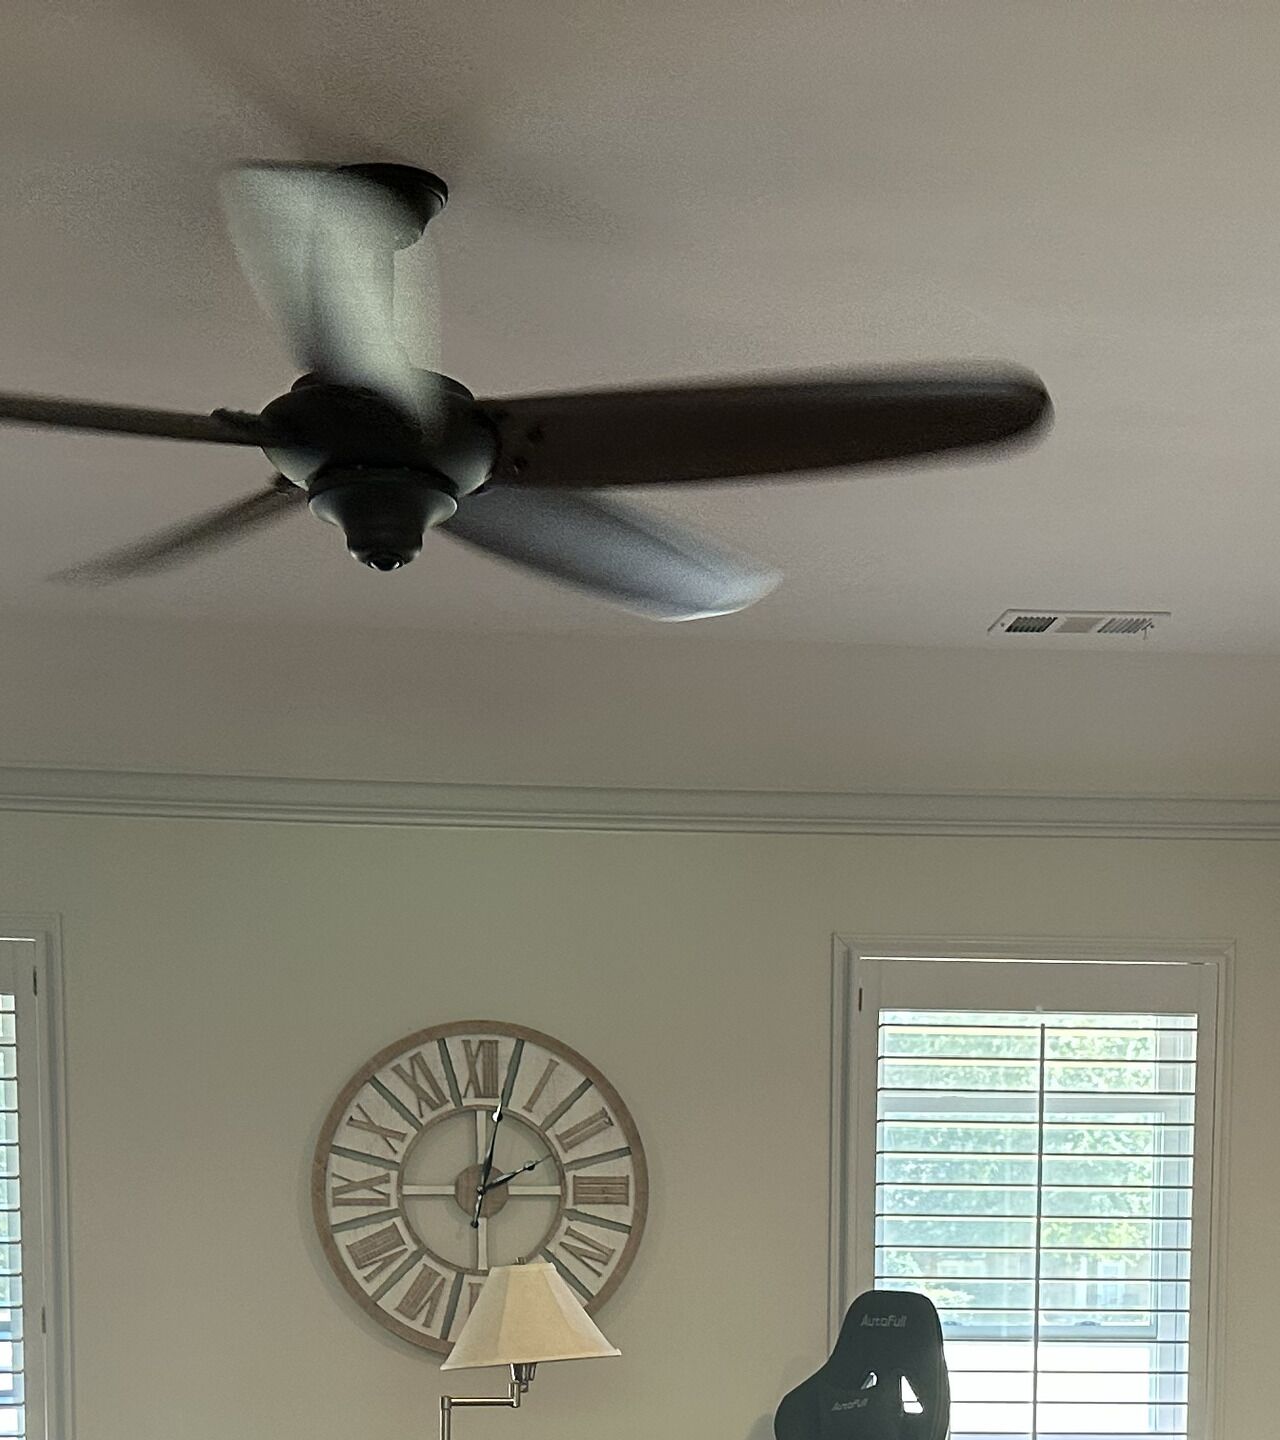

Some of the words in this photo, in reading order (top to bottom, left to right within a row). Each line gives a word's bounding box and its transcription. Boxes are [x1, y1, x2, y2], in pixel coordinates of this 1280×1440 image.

[391, 1051, 450, 1119] XI
[462, 1039, 500, 1099] XII
[522, 1058, 560, 1113] I
[347, 1103, 408, 1154] X
[555, 1106, 614, 1154] II
[332, 1172, 391, 1207] IX
[573, 1174, 630, 1206] III
[345, 1222, 409, 1283] VIII
[559, 1226, 616, 1278] IV
[394, 1263, 447, 1329] VII
[860, 1314, 908, 1328] AutoFull
